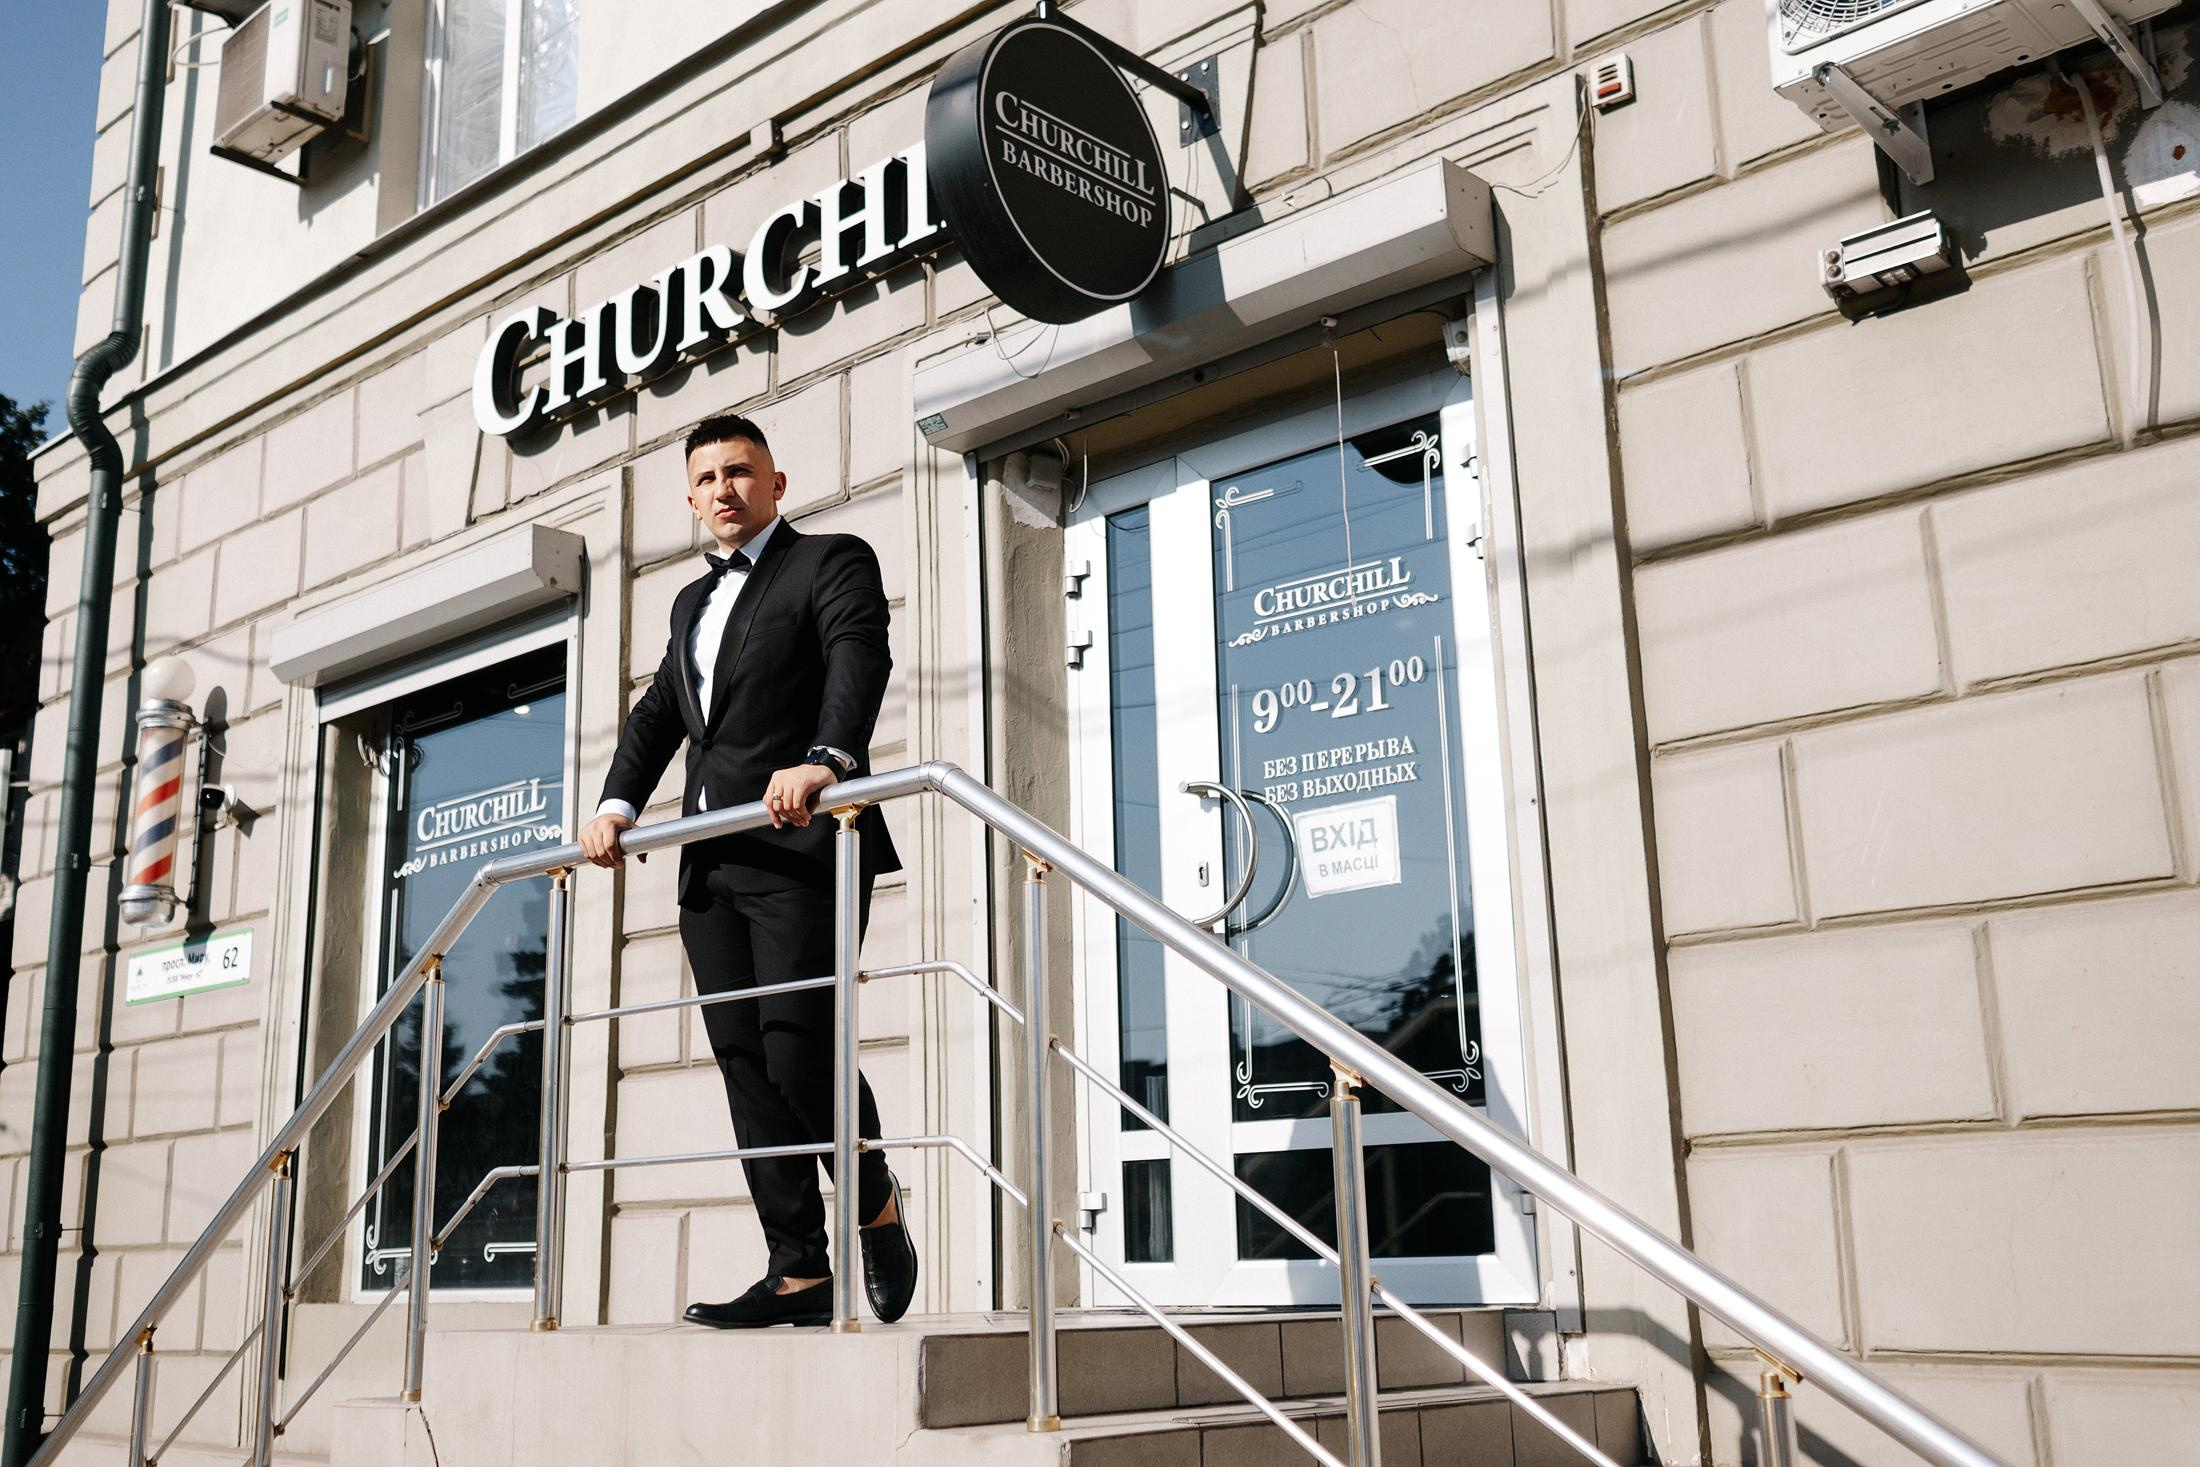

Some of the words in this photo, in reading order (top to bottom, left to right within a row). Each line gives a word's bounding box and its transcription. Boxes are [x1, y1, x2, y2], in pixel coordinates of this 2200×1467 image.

[995, 91, 1155, 196] CHURCHILL
[1002, 139, 1152, 228] BARBERSHOP
[472, 139, 947, 436] CHURCHI
[1253, 556, 1411, 617] CHURCHILL
[1271, 599, 1390, 637] BARBERSHOP
[1263, 756, 1298, 779] БЕЗ
[1301, 735, 1415, 773] ПЕРЕРЫВА
[1264, 781, 1299, 805] БЕЗ
[1302, 761, 1417, 799] ВЫХОДНЫХ
[416, 777, 547, 842] CHURCHILL
[429, 828, 533, 868] BARBERSHOP
[1310, 818, 1378, 853] ВХІД
[1319, 863, 1329, 878] В
[222, 946, 239, 969] 62
